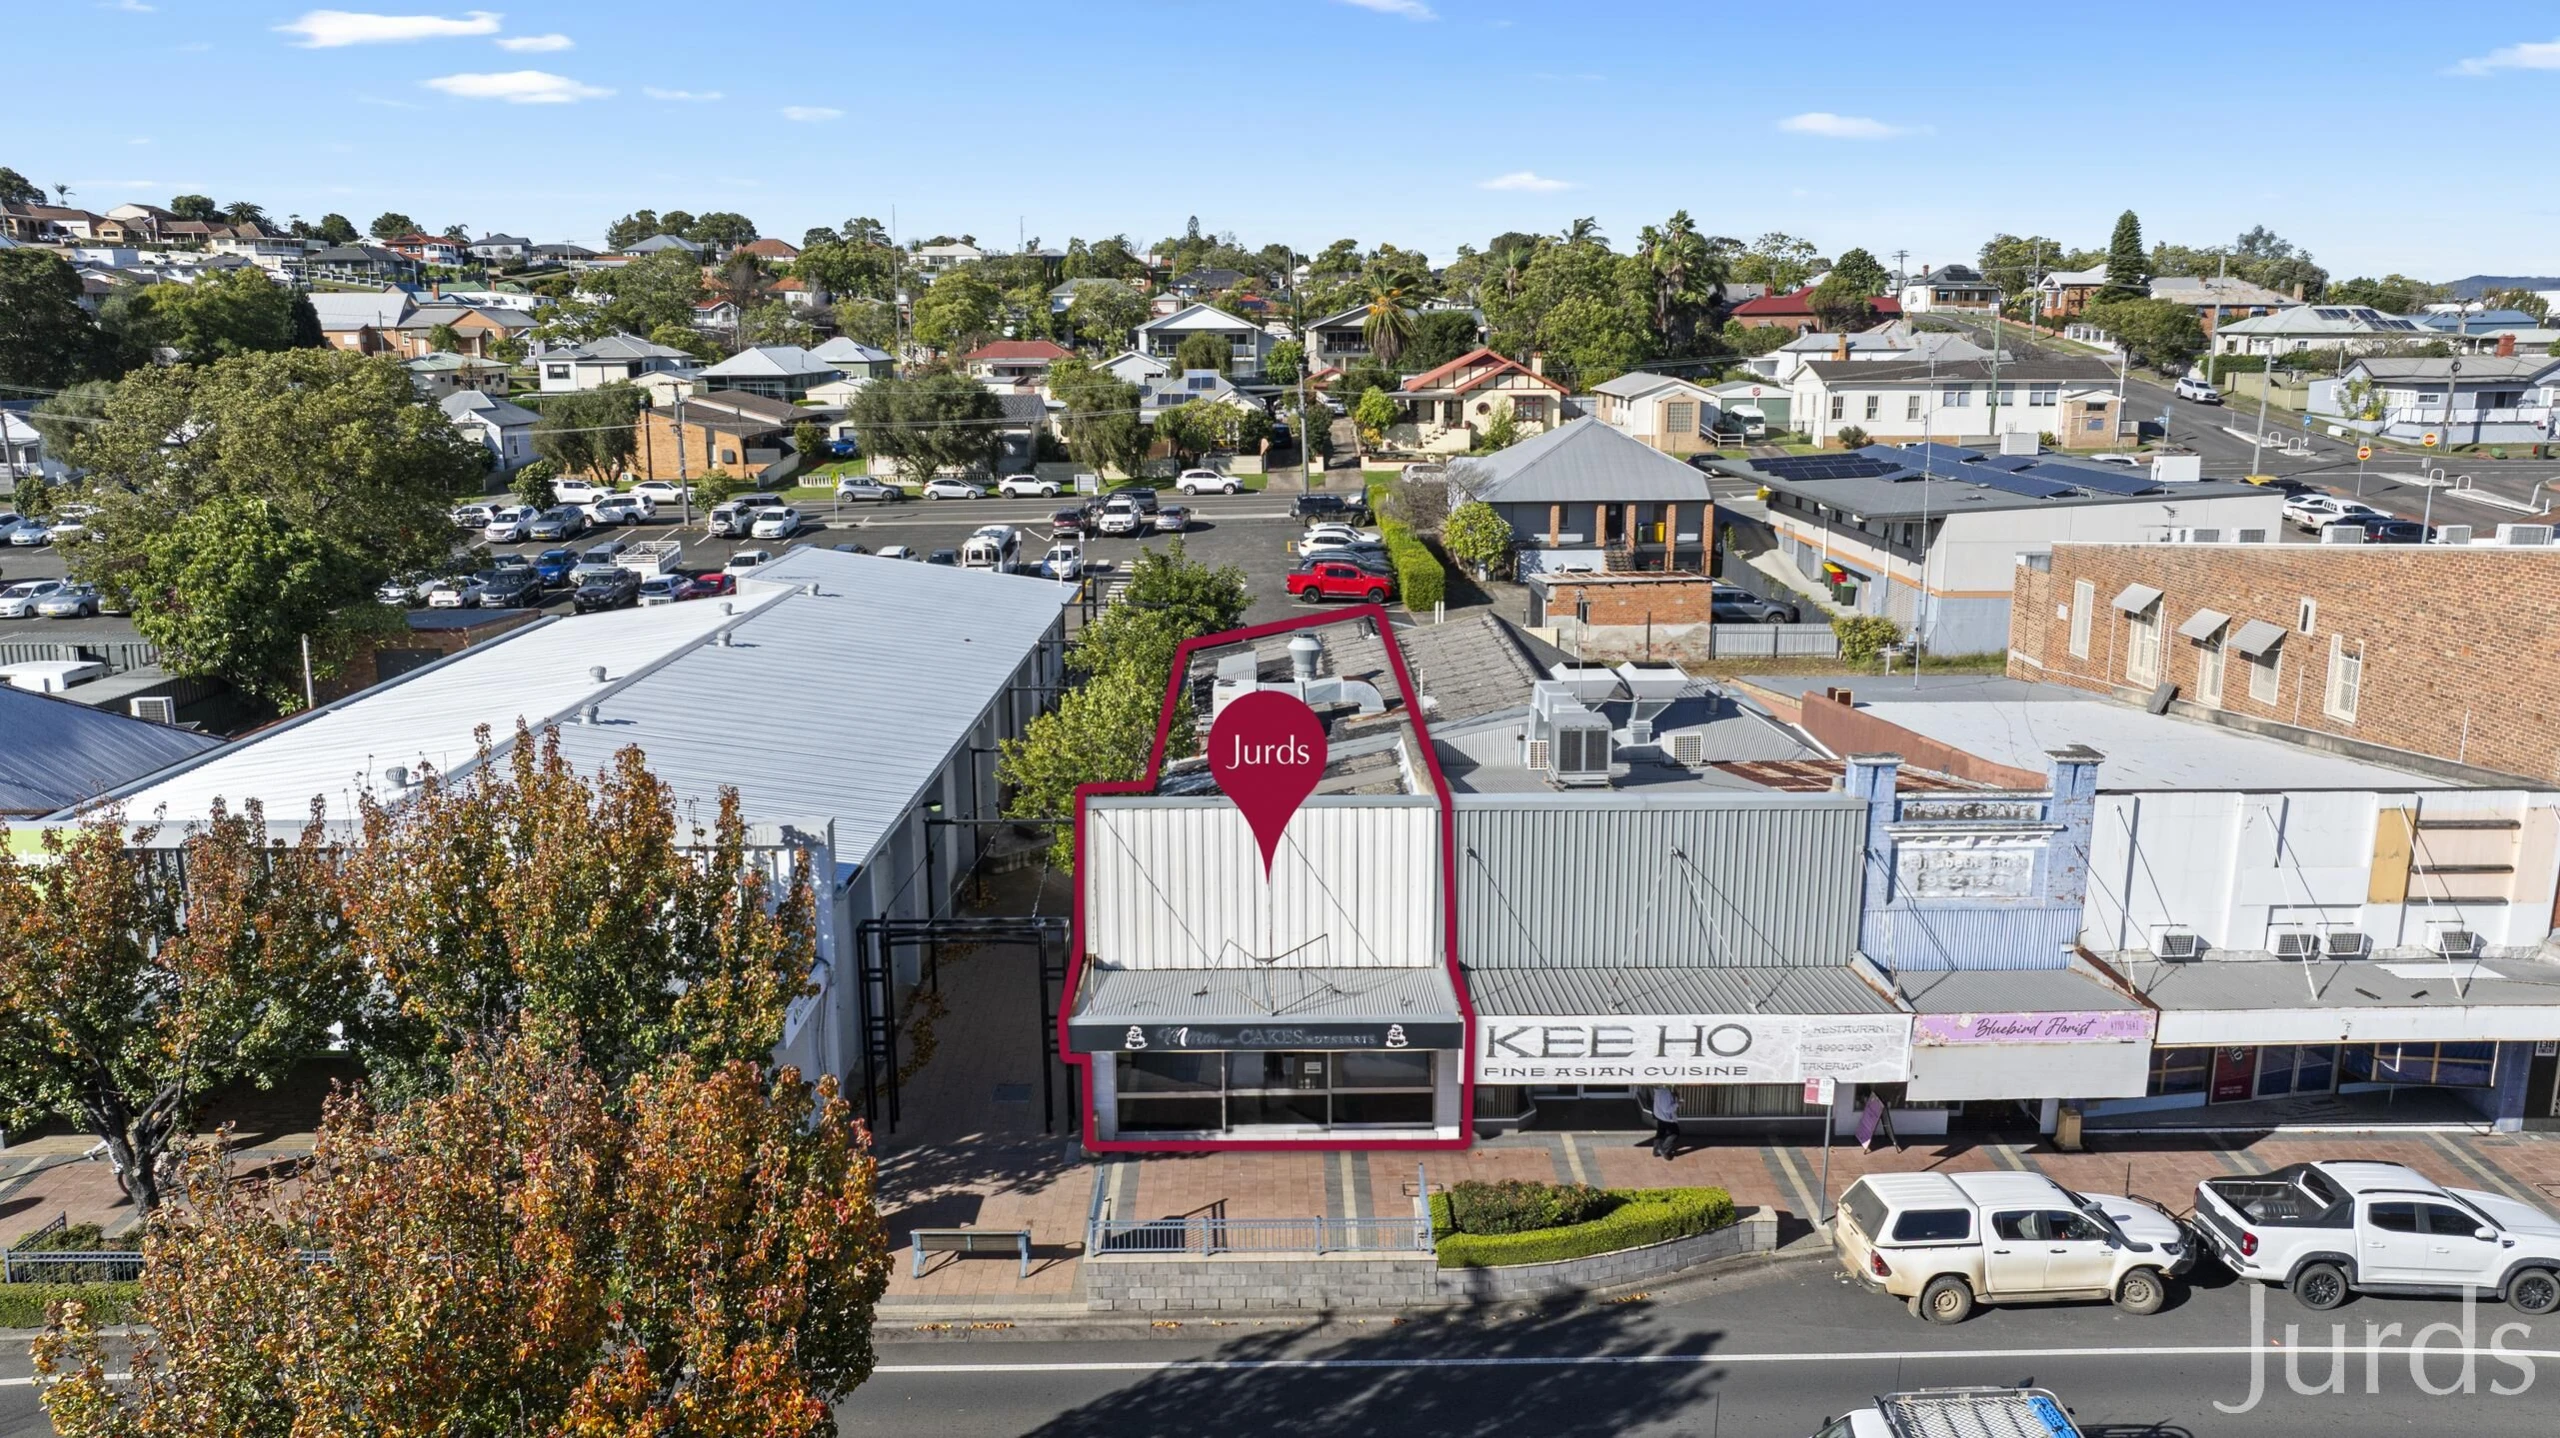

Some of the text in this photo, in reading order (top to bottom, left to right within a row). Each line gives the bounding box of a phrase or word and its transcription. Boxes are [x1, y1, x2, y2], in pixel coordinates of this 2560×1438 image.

[1238, 1028, 1303, 1045] CAKES
[1974, 1017, 2043, 1038] Bluebird
[2045, 1017, 2097, 1036] Florist
[1485, 1023, 1753, 1059] KEE HO
[1484, 1066, 1749, 1077] FINE ASIAN CUISINE
